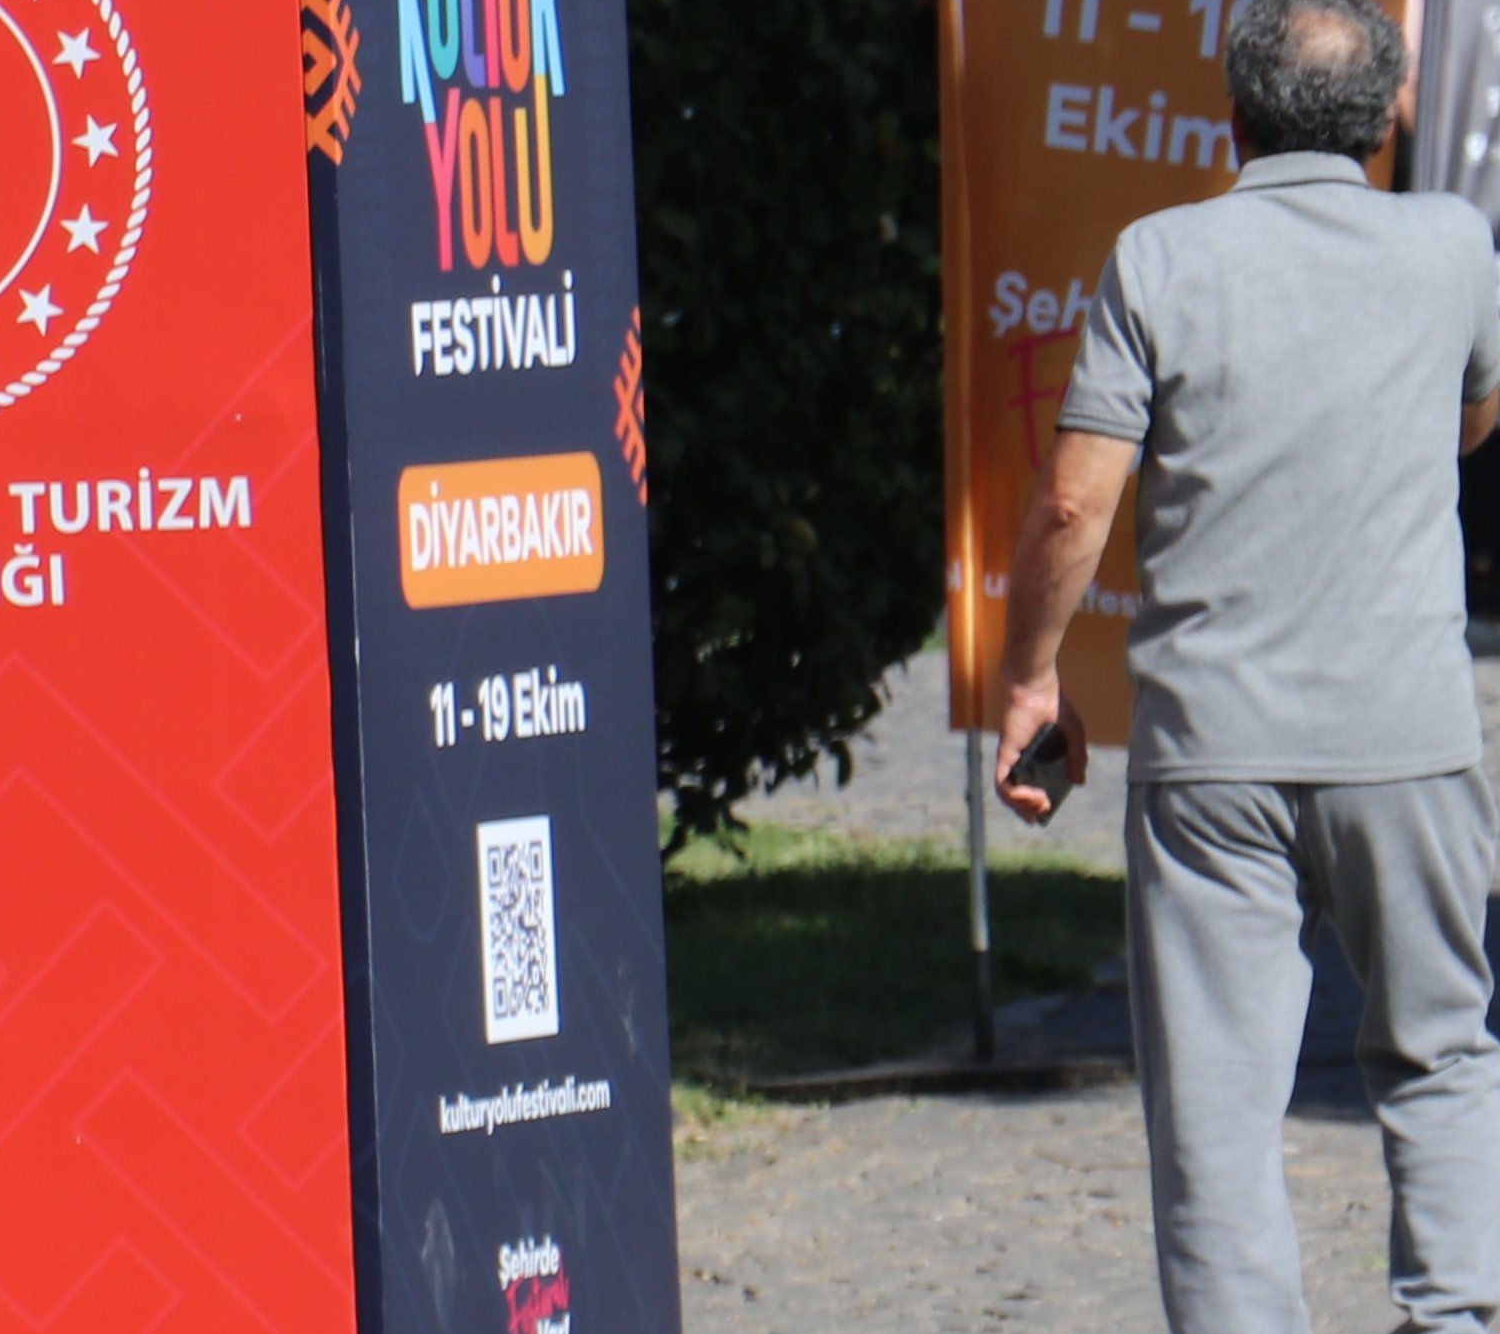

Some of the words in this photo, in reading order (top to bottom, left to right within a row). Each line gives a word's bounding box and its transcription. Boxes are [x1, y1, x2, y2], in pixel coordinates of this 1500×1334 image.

[423, 73, 555, 272] YOLU
[410, 269, 577, 377] FESTİVALİ
[9, 467, 254, 534] TURİZM
[408, 479, 594, 572] DİYARBAKIR
[513, 664, 587, 739] Ekim
[438, 1073, 612, 1137] kulturyolufestivali.com
[498, 1233, 561, 1292] Şehirde
